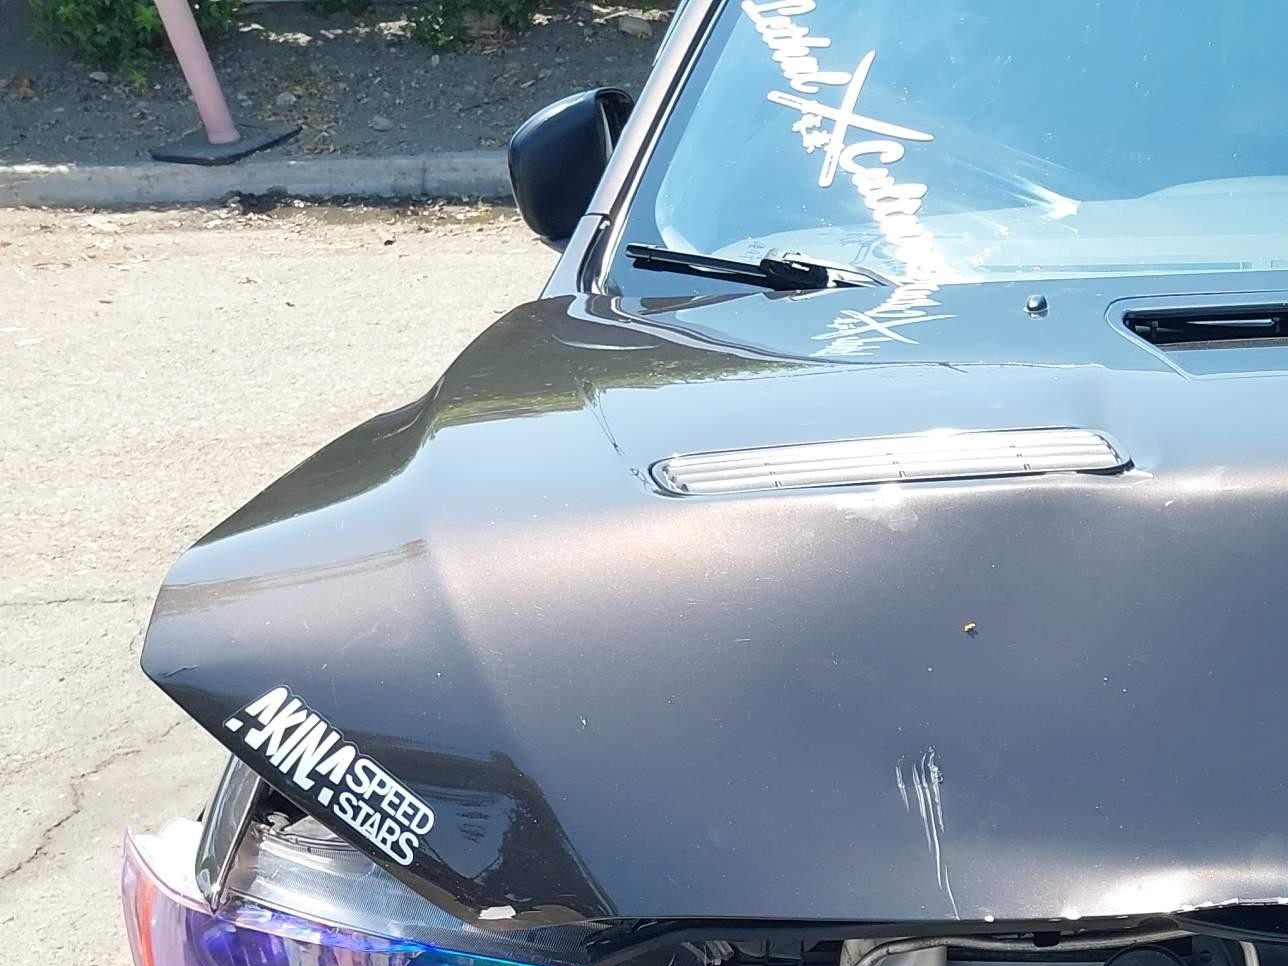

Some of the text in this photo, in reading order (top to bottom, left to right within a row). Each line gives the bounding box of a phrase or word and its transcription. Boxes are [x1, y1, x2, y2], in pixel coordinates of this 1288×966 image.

[225, 686, 435, 836] AKINA SPEED
[333, 791, 419, 867] STARS
